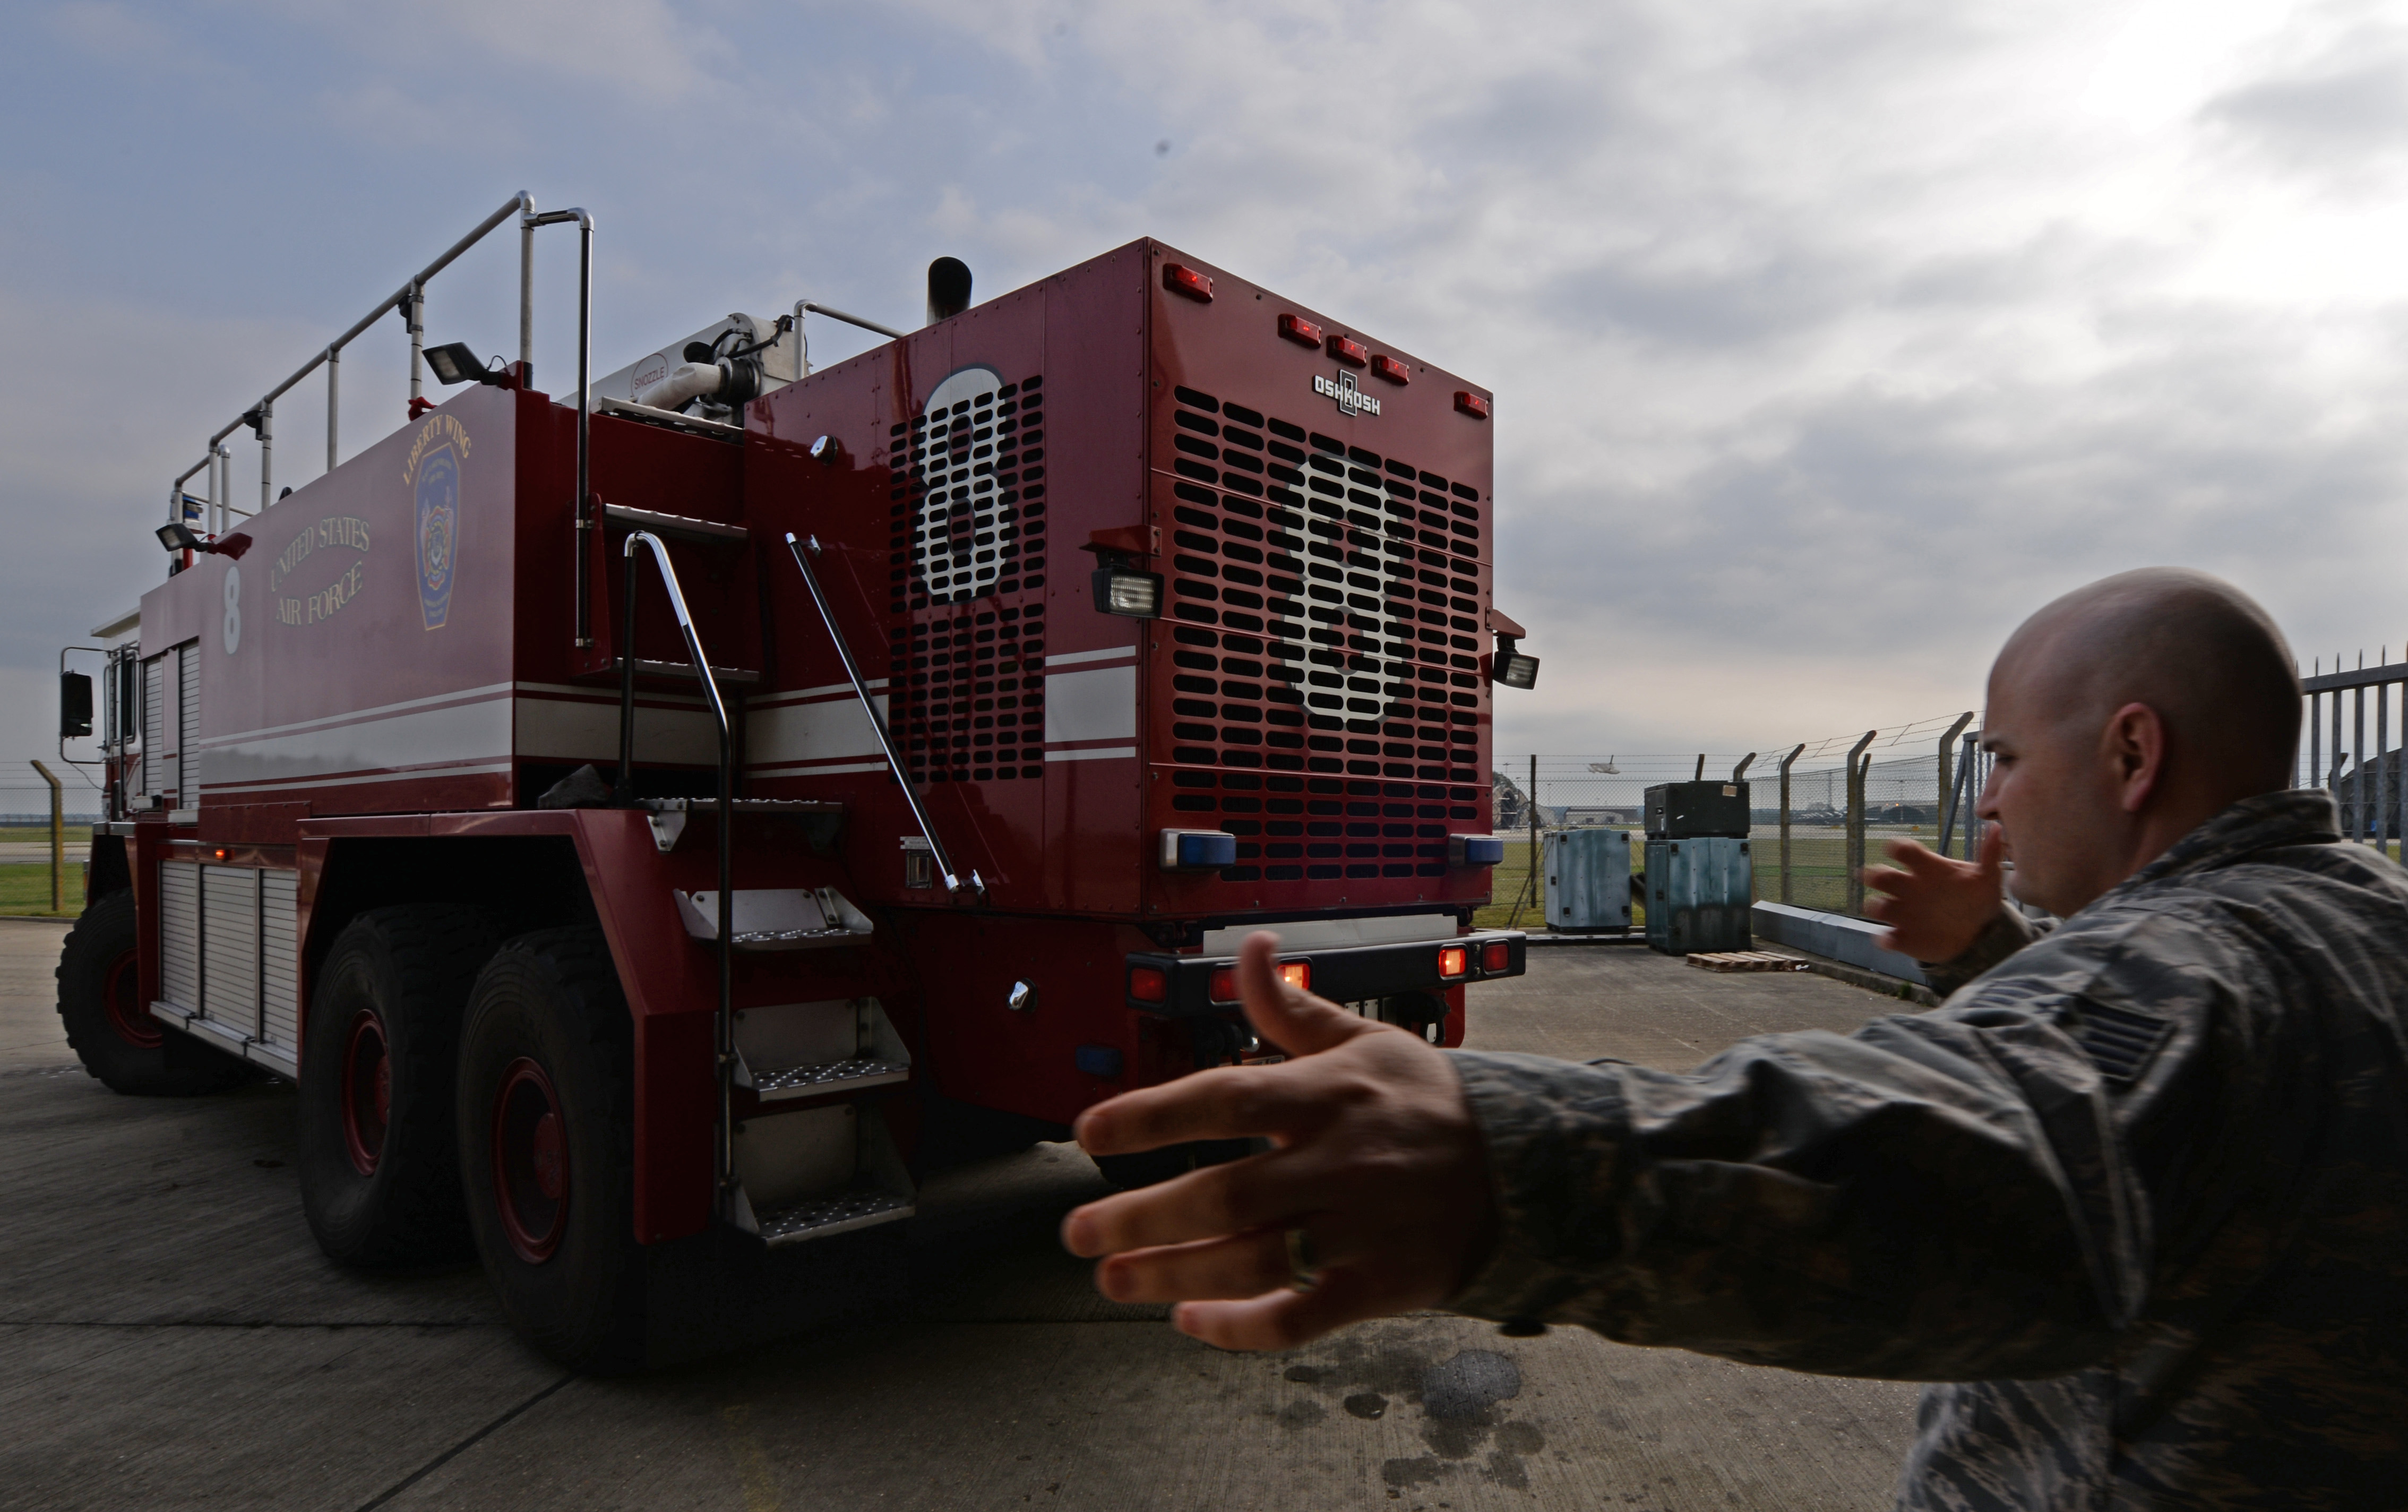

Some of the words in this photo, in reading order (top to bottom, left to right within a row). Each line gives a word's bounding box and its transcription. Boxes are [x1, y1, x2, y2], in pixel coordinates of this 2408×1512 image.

[634, 366, 664, 390] SNOZZLE
[1314, 374, 1380, 416] OSHKOSH
[403, 414, 443, 485] LIBERTY
[445, 414, 471, 459] WING
[914, 365, 1012, 604] 8
[271, 526, 314, 592] UNITED
[319, 517, 370, 552] STATES
[223, 565, 241, 655] 8
[276, 598, 302, 625] AIR
[308, 560, 363, 624] FORCE
